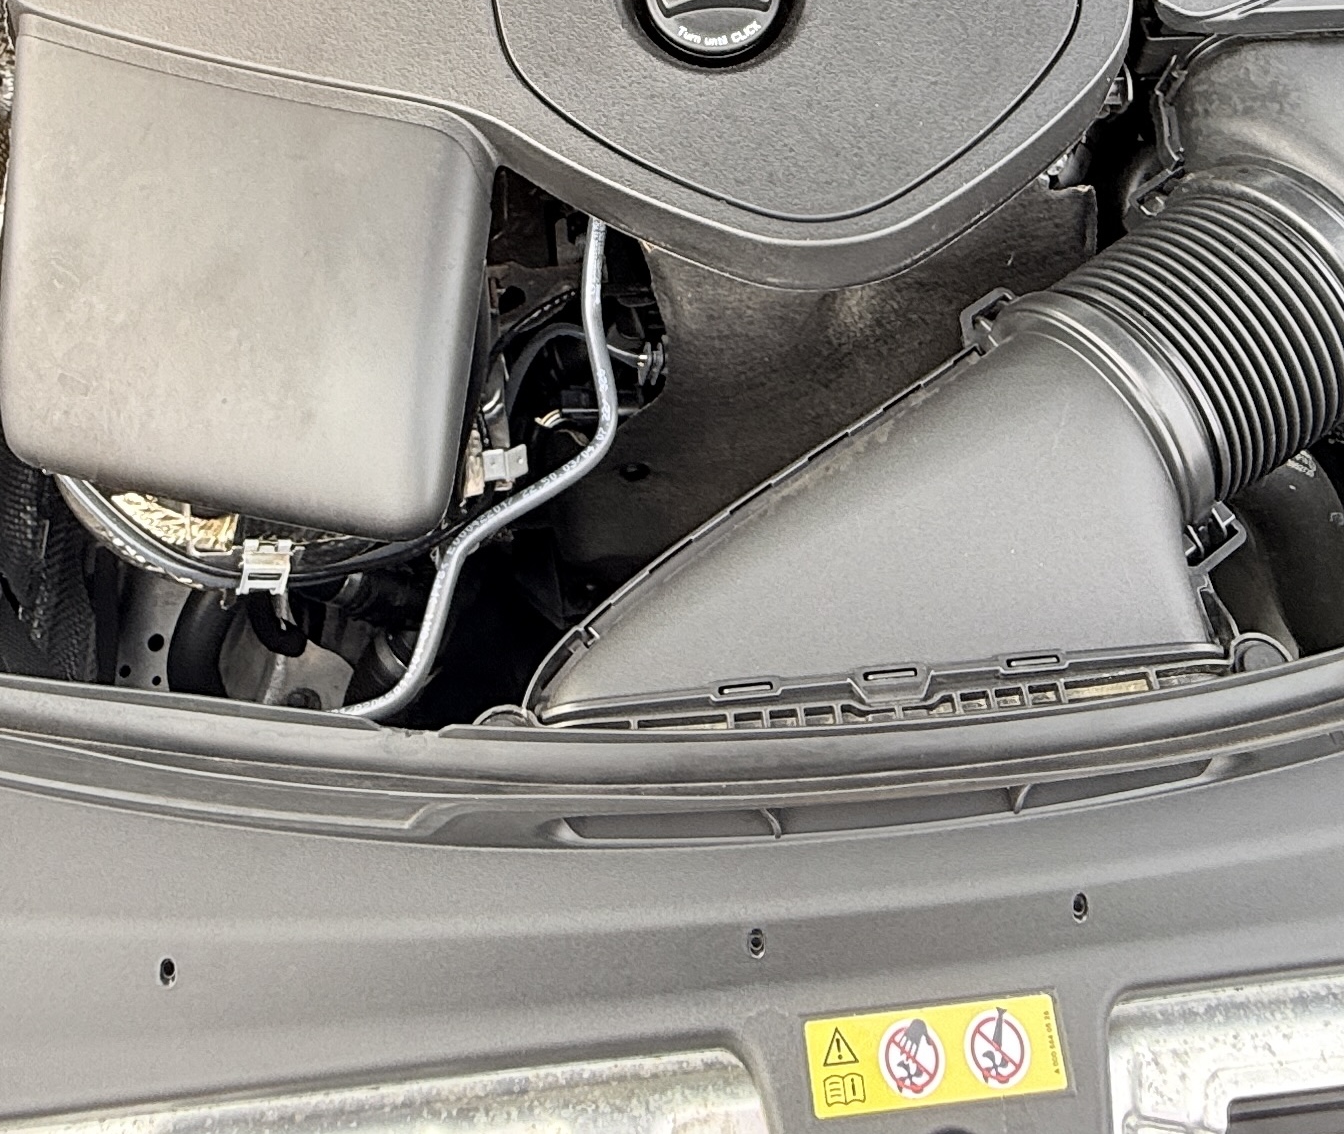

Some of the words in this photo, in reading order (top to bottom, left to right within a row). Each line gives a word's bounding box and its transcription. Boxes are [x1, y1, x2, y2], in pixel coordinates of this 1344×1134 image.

[677, 25, 701, 44] Turn
[703, 34, 728, 46] until
[730, 19, 761, 43] CLICK
